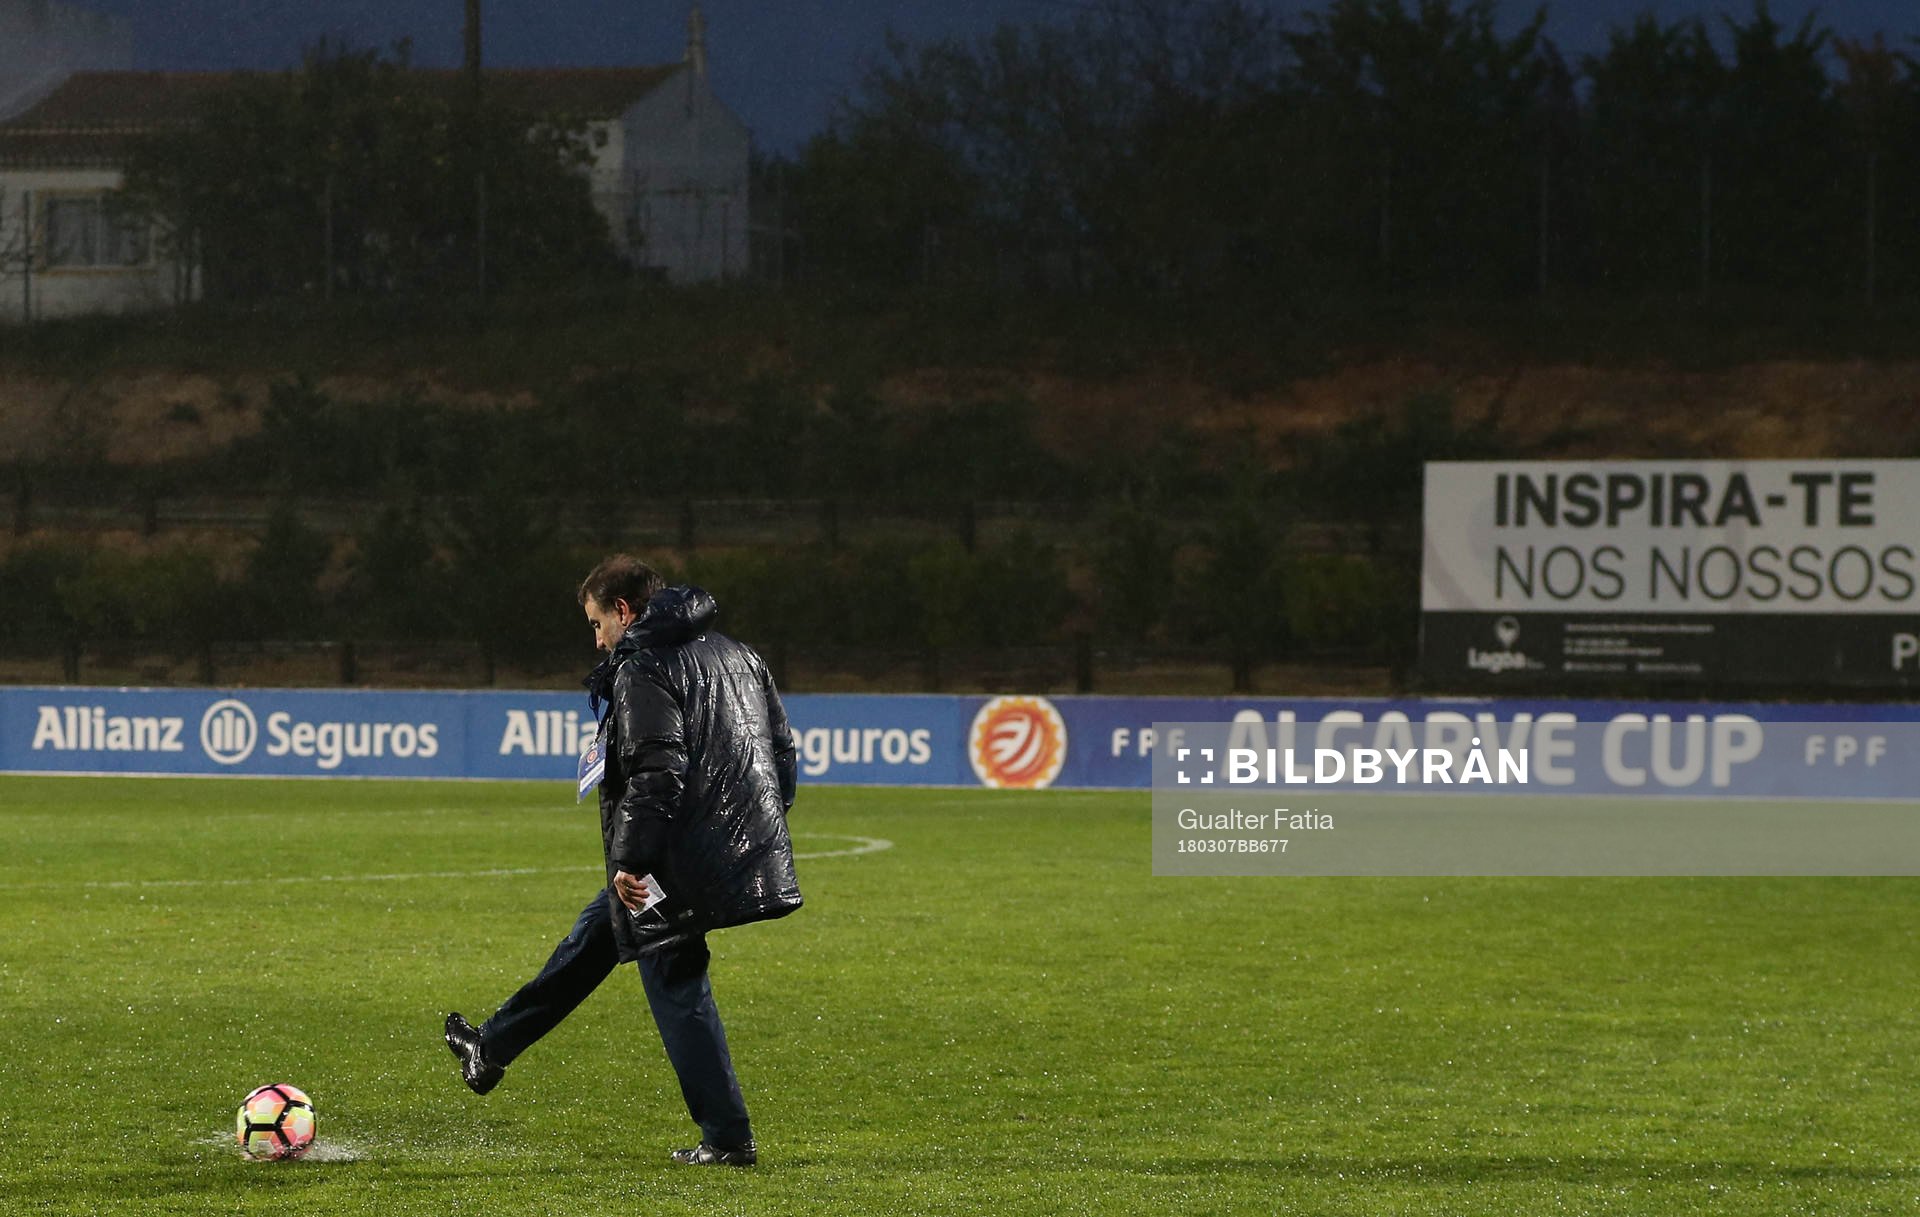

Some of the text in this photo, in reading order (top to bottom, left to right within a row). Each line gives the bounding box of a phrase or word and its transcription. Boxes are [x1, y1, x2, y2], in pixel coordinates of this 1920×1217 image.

[1495, 473, 1876, 527] INSPIRA-TE
[1495, 545, 1916, 601] NOS NOSSOS
[32, 706, 439, 769] Allianz Seguros
[1111, 728, 1187, 758] FPF
[1602, 712, 1764, 787] CUP
[1805, 735, 1888, 767] FPF
